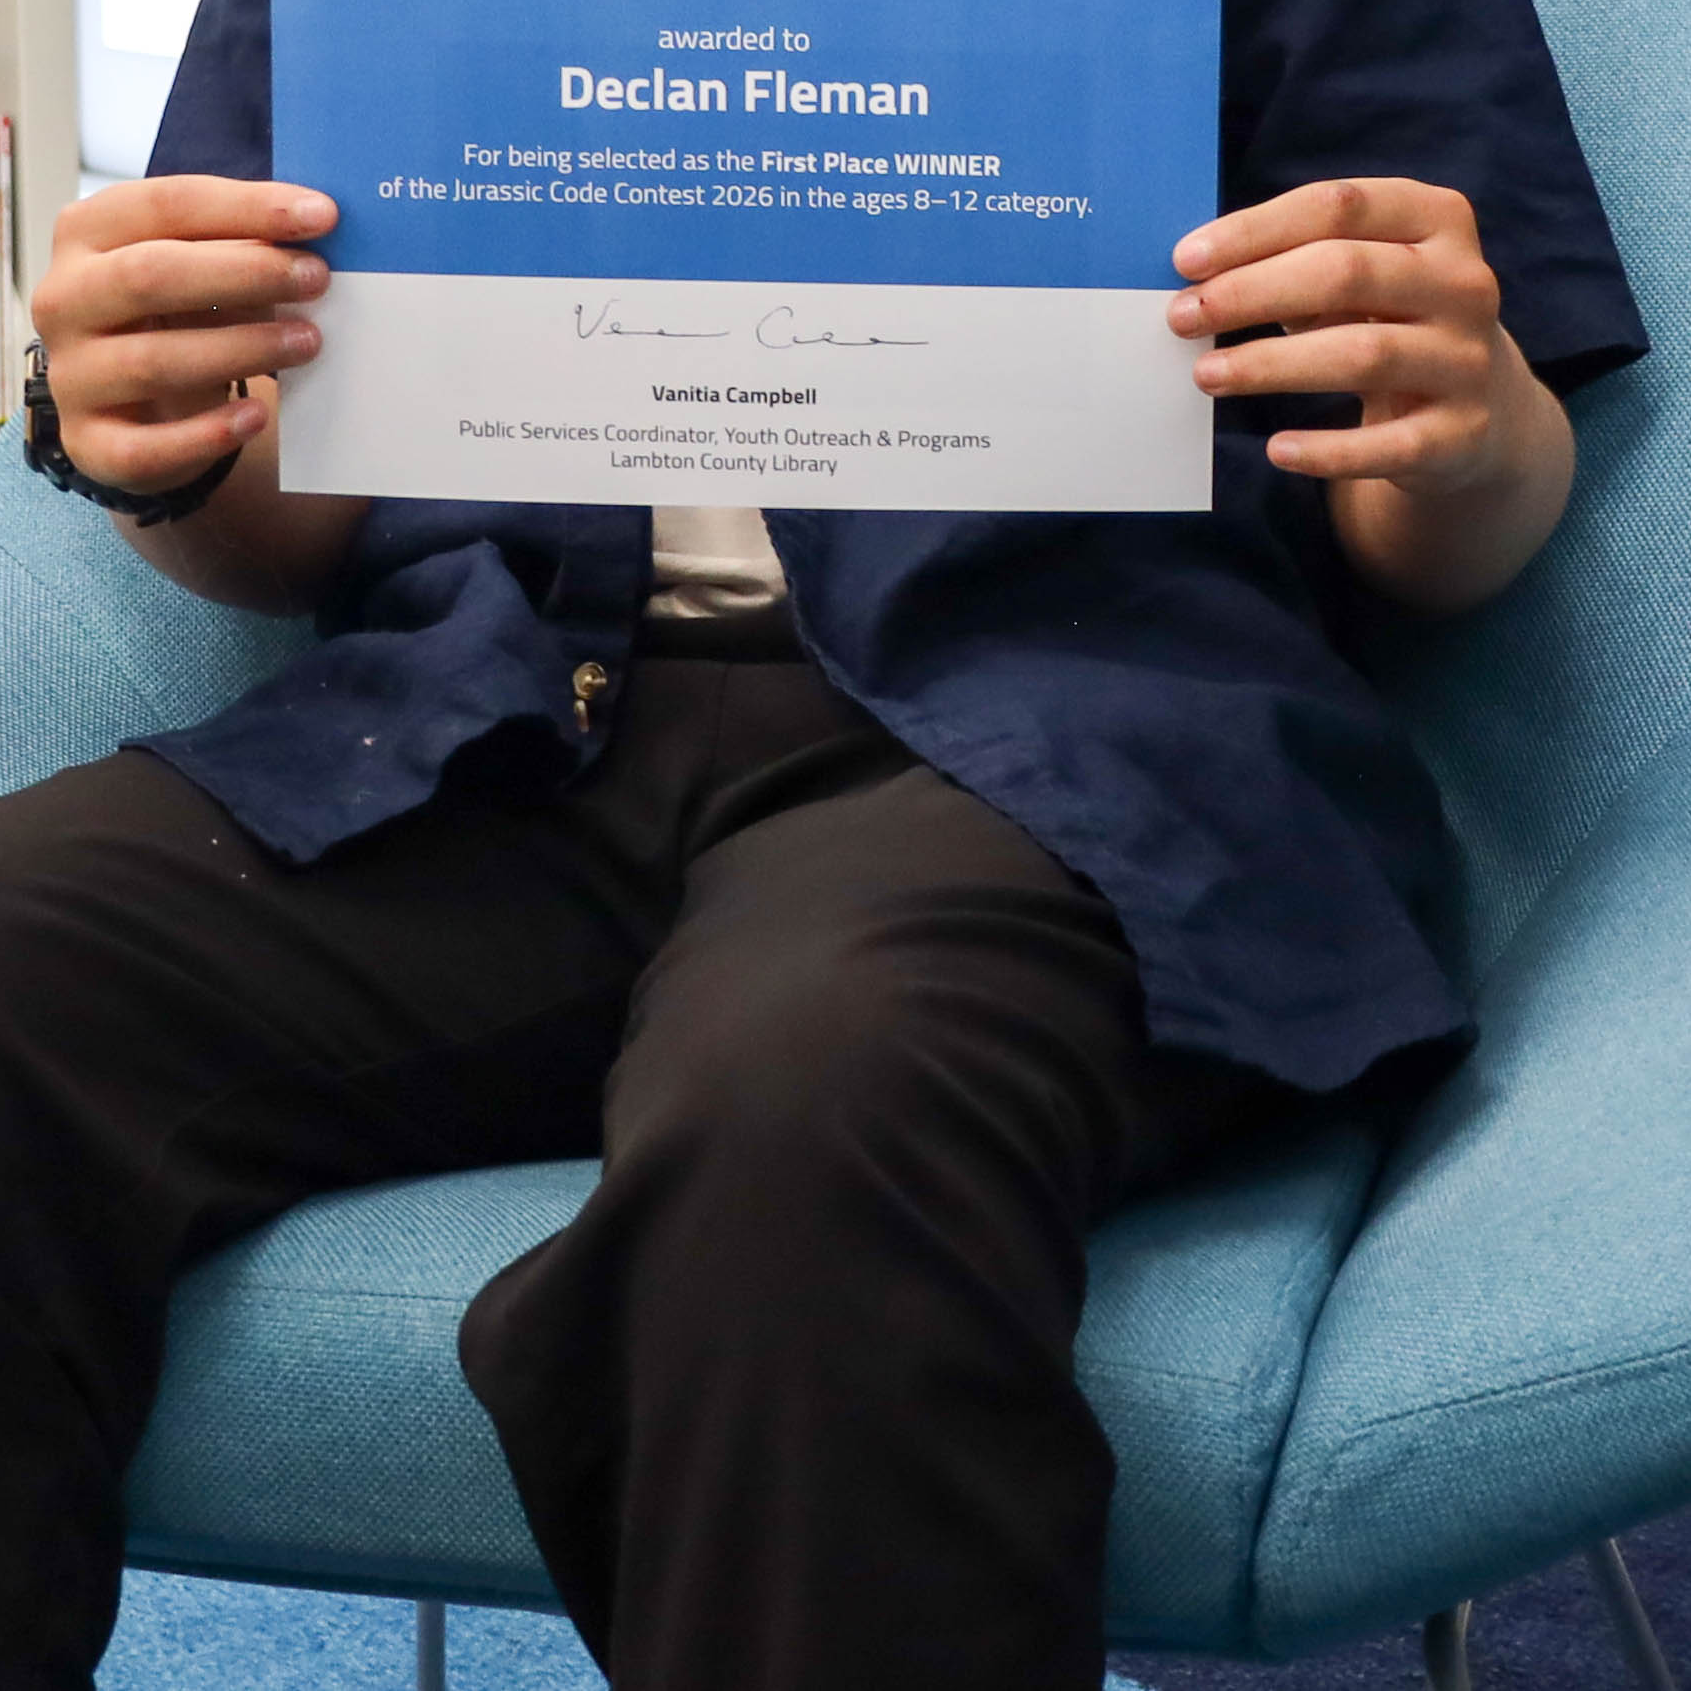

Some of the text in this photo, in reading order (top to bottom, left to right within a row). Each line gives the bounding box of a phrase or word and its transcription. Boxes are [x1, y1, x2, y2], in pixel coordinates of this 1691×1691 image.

[658, 25, 811, 52] awarded to
[560, 66, 929, 116] Declan Fleman
[464, 143, 1001, 177] For being selected as the First Place WINNER
[379, 176, 403, 198] of
[408, 176, 447, 200] the
[453, 178, 543, 202] Jurassic
[549, 180, 608, 204] Code
[614, 182, 705, 206] Contest
[712, 185, 774, 207] 2026
[780, 185, 800, 207] in
[807, 186, 846, 209] the
[852, 192, 908, 215] ages
[985, 191, 1093, 219] category.
[652, 385, 817, 408] Vanitia Campbell
[459, 420, 991, 453] Public Services Coordinator, Youth Outreach & Programs
[611, 452, 837, 476] Lambton County Library
